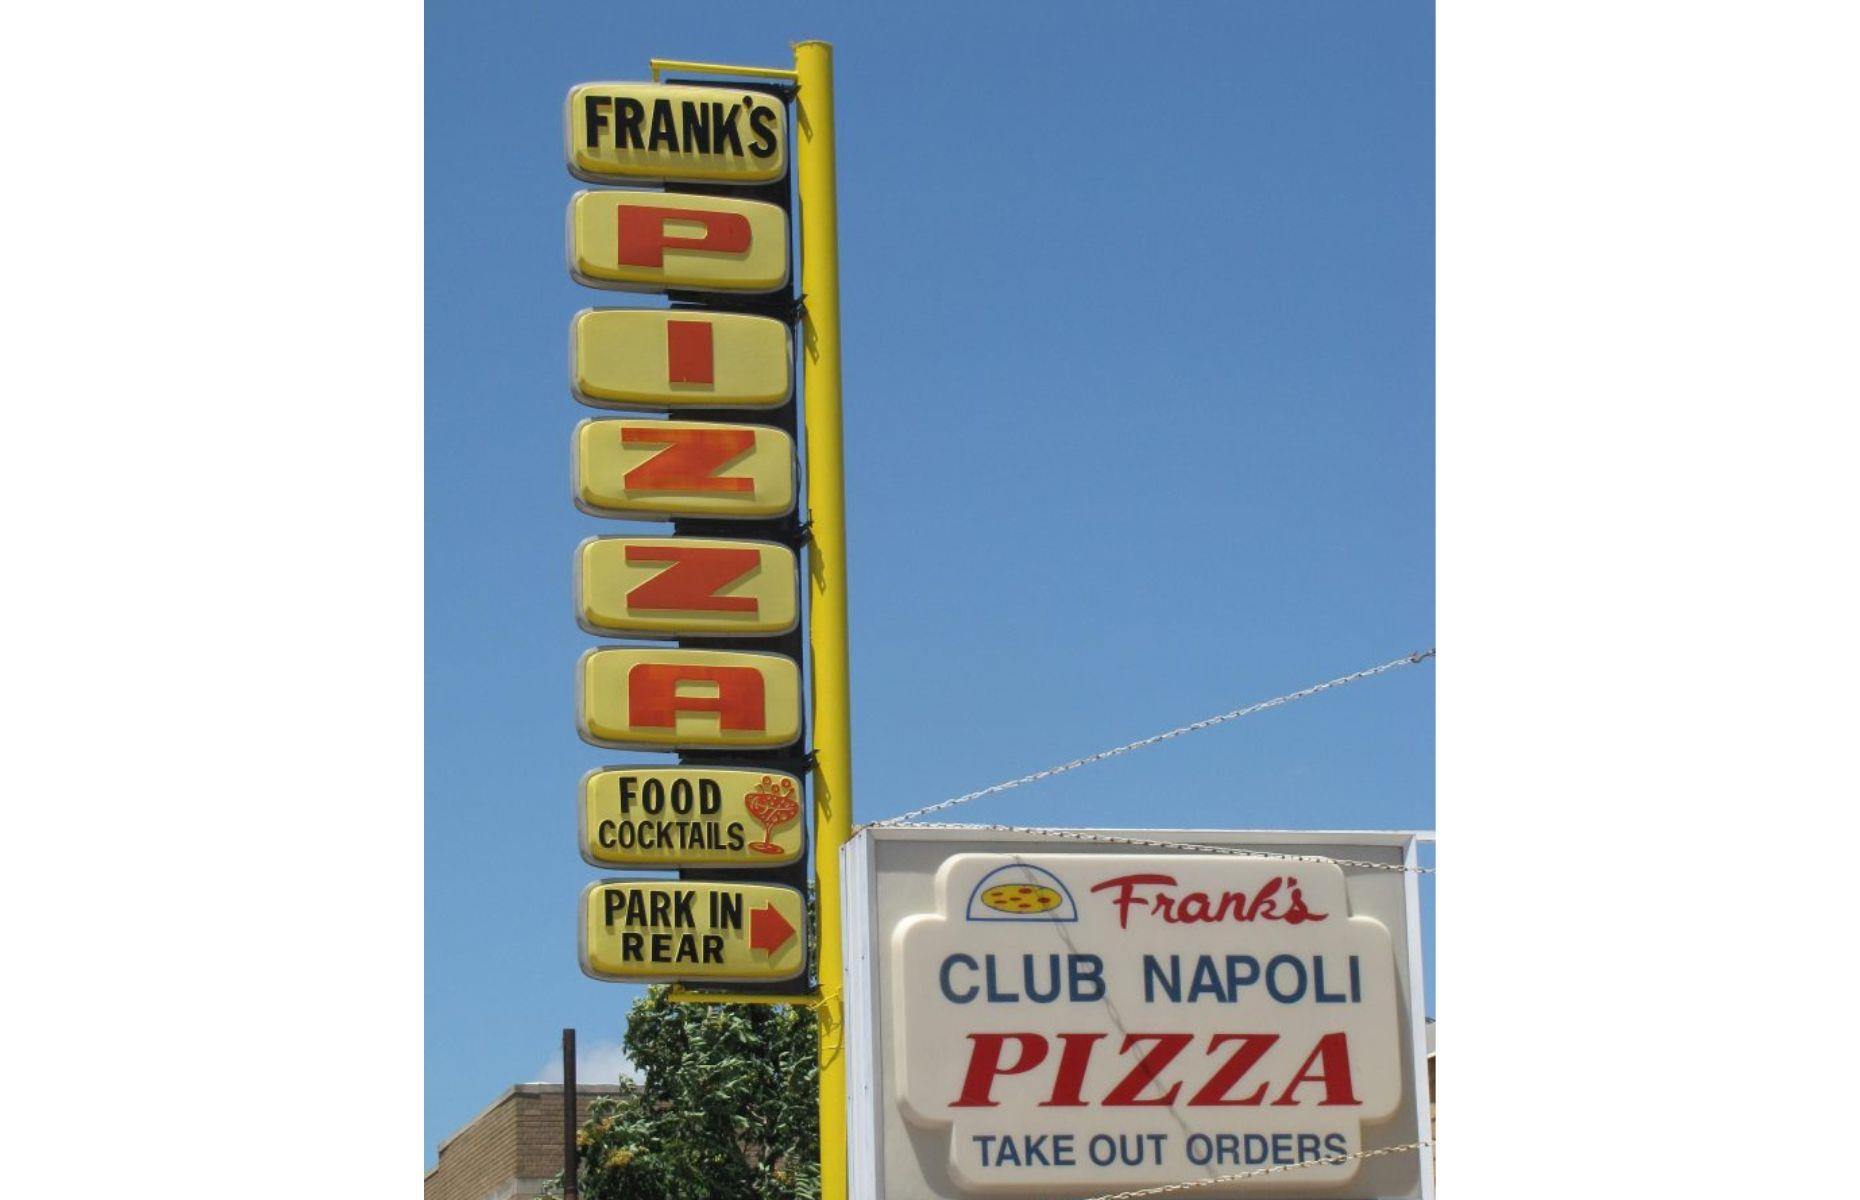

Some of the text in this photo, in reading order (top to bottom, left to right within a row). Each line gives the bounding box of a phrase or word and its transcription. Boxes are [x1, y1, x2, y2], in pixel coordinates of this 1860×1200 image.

[585, 95, 778, 158] FRANK'S
[617, 204, 767, 731] PIZZA
[618, 776, 722, 815] FOOD
[598, 819, 745, 850] COCKTAILS
[604, 889, 743, 929] PARK IN
[1090, 873, 1329, 930] Frank's
[621, 932, 725, 964] REAR
[939, 953, 1362, 1004] CLUB NAPOLI
[947, 1031, 1364, 1109] PIZZA
[973, 1132, 1349, 1167] TAKE OUT ORDERS
